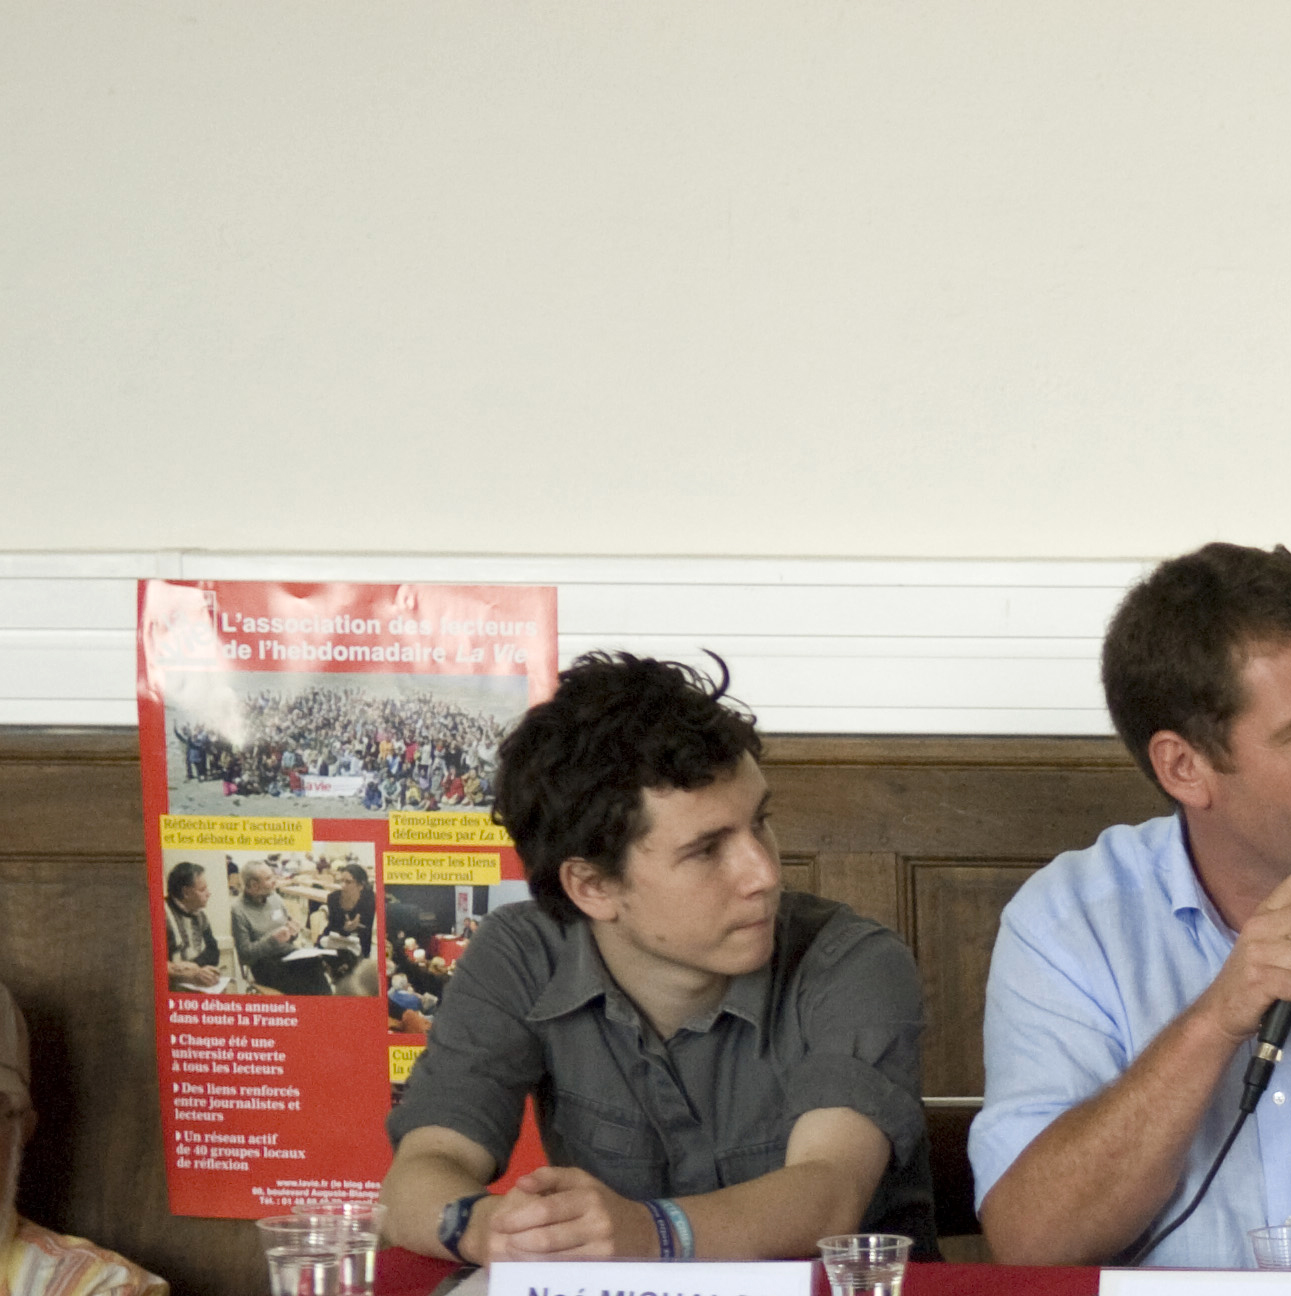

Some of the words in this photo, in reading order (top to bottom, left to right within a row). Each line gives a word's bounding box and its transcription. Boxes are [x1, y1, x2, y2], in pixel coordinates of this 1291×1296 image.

[221, 612, 381, 634] L'association
[388, 615, 433, 636] des
[440, 617, 538, 637] lecteurs
[223, 640, 252, 660] de
[258, 640, 447, 662] l'hebdomadaire
[455, 645, 484, 663] La
[493, 643, 529, 664] Vie
[220, 821, 239, 831] sur
[392, 815, 457, 827] Témoigner
[460, 816, 480, 826] des
[164, 833, 175, 843] et
[177, 832, 194, 843] les
[237, 834, 251, 844] de
[392, 829, 452, 840] défendues
[456, 831, 475, 842] par
[479, 830, 494, 840] La
[387, 855, 445, 867] Renforcer
[448, 856, 465, 867] les
[467, 856, 497, 867] liens
[387, 871, 413, 880] avec
[416, 869, 428, 880] le
[430, 870, 474, 882] journal
[178, 999, 199, 1011] 100
[201, 1000, 243, 1013] débats
[245, 1001, 297, 1013] annuels
[170, 1012, 199, 1024] dans
[202, 1014, 235, 1025] toute
[238, 1014, 250, 1025] la
[253, 1014, 298, 1027] France
[179, 1034, 226, 1049] Chaque
[228, 1035, 248, 1047] été
[251, 1037, 275, 1048] une
[171, 1047, 234, 1060] université
[237, 1051, 286, 1062] ouverte
[172, 1061, 180, 1072] à
[183, 1062, 209, 1073] tous
[212, 1062, 230, 1073] les
[233, 1062, 284, 1075] lecteurs
[182, 1083, 204, 1094] Des
[207, 1083, 236, 1095] liens
[239, 1084, 300, 1097] renforcés
[174, 1097, 207, 1107] entre
[209, 1097, 285, 1110] journalistes
[288, 1099, 301, 1111] et
[175, 1108, 224, 1122] lecteurs
[184, 1131, 201, 1142] Un
[204, 1132, 245, 1144] réseau
[248, 1133, 279, 1145] actif
[176, 1144, 191, 1155] de
[194, 1145, 208, 1156] 40
[210, 1146, 261, 1159] groupes
[263, 1147, 306, 1159] locaux
[177, 1156, 192, 1168] de
[194, 1157, 249, 1171] réflexion
